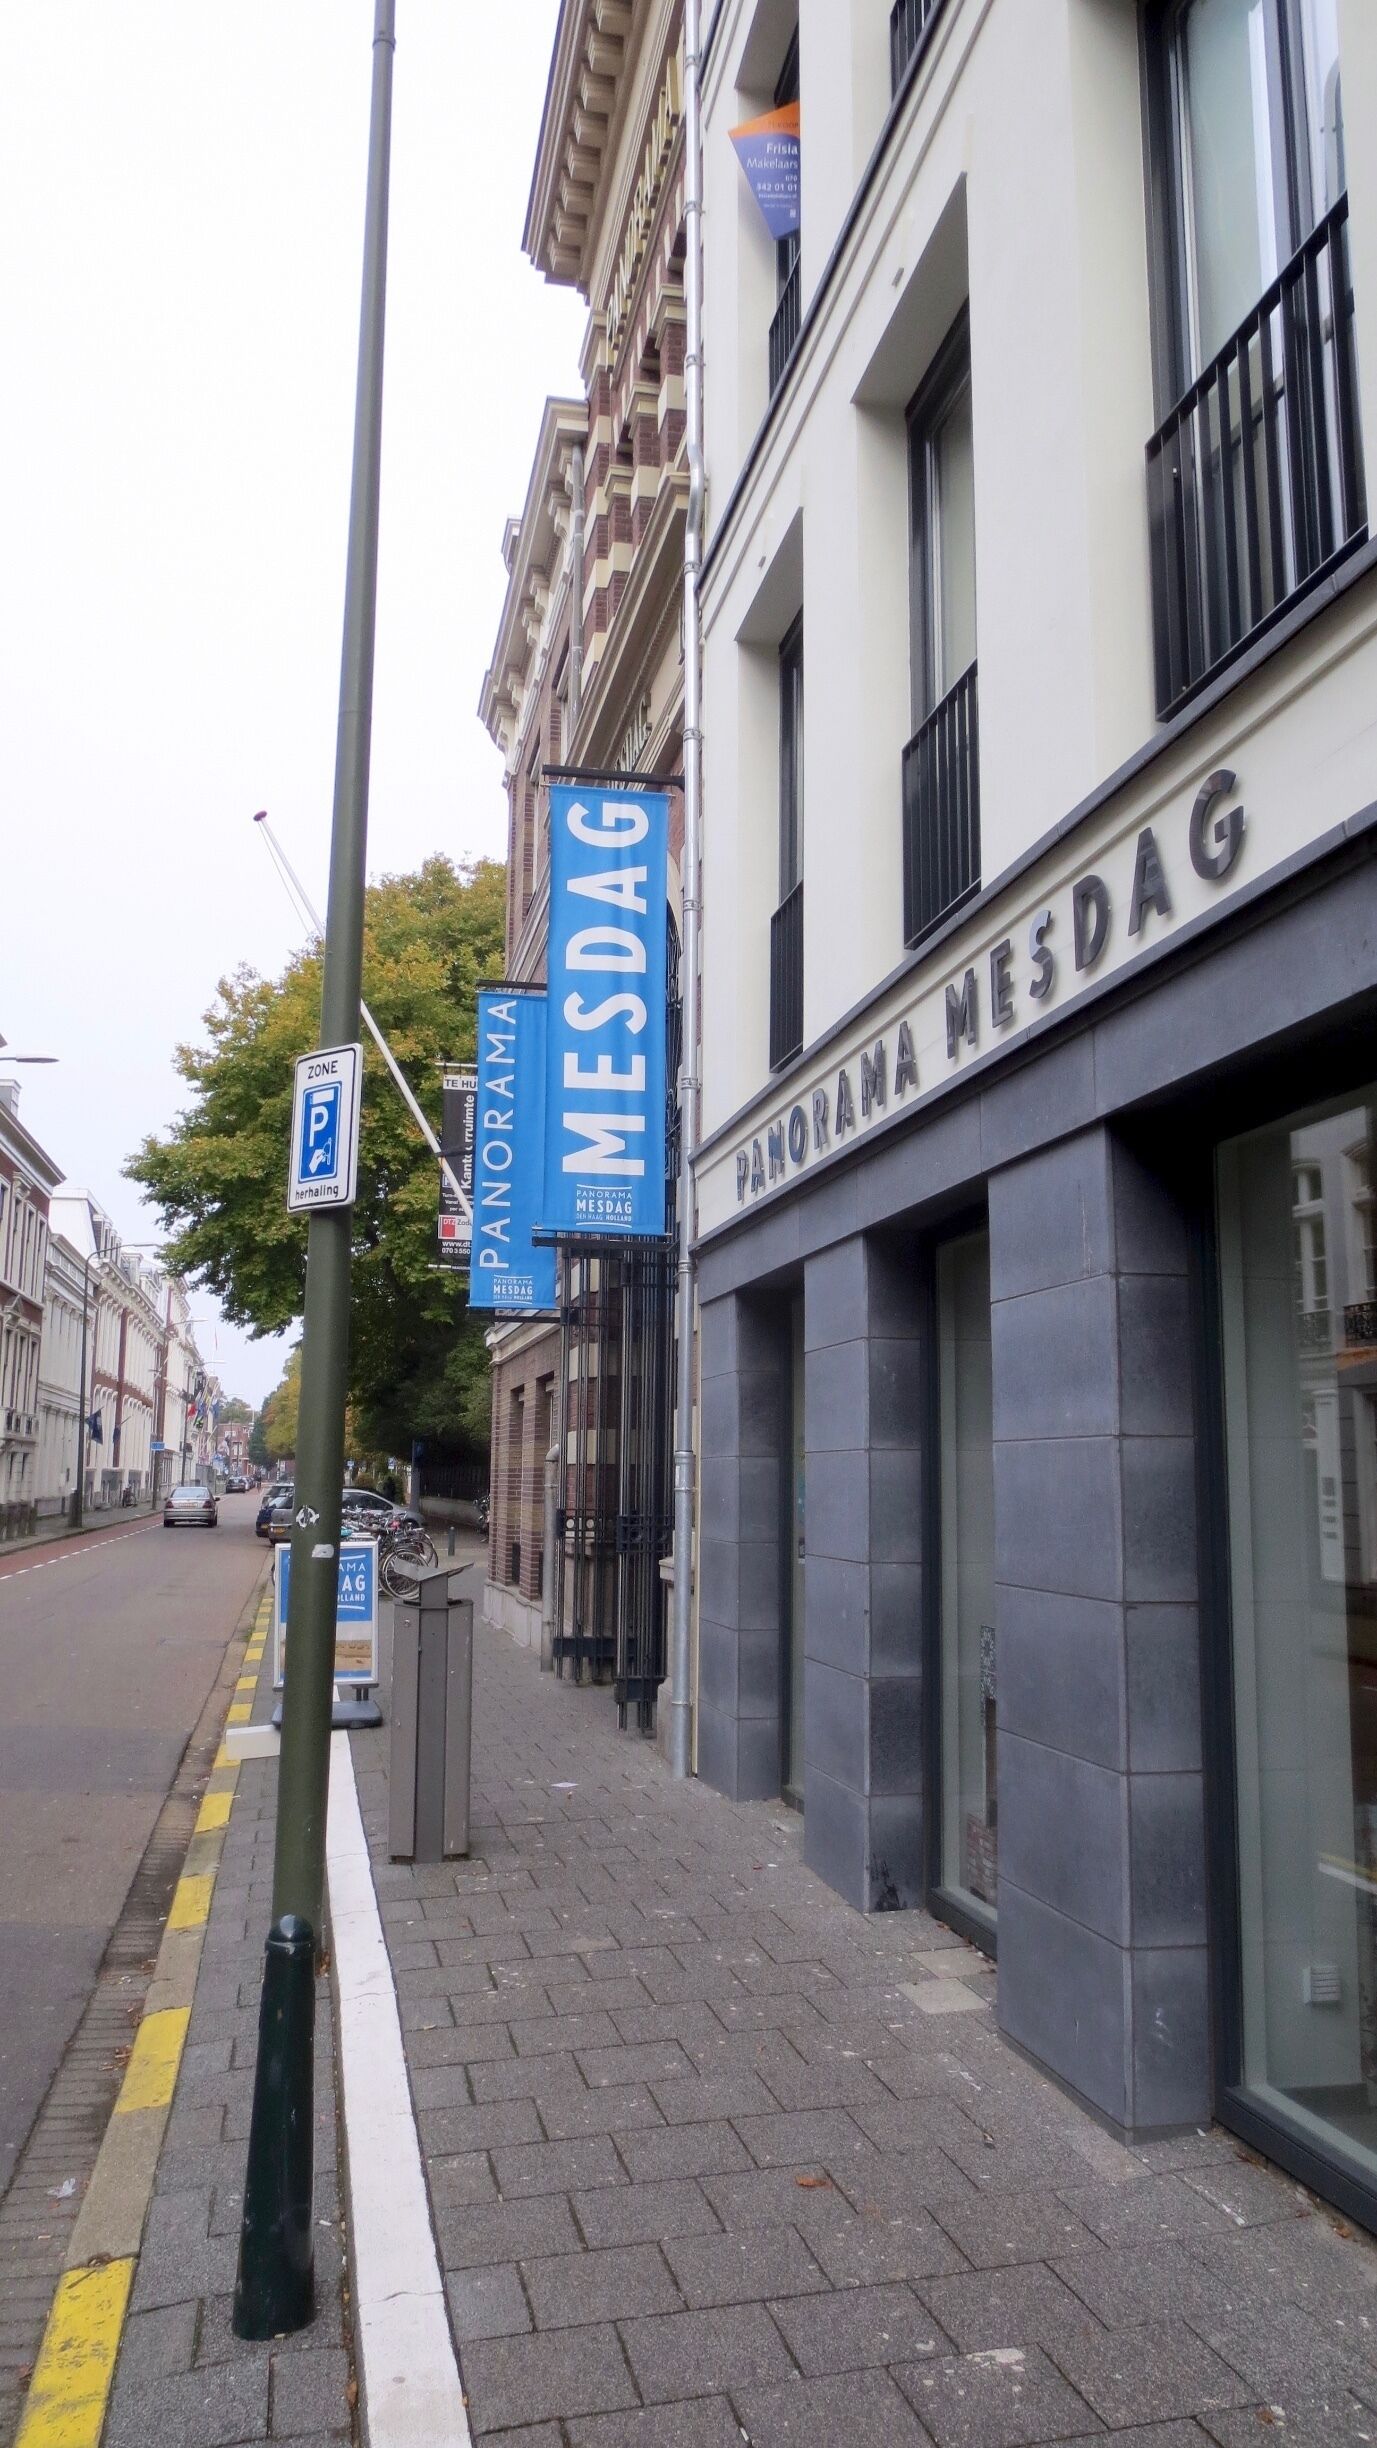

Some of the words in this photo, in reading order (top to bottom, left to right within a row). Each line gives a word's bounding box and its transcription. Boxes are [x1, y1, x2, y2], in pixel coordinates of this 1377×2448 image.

[766, 142, 798, 155] Frisia
[746, 158, 798, 169] Makelaars
[561, 801, 650, 1177] MESDAG
[736, 1020, 917, 1202] PANORAMA
[944, 769, 1245, 1060] MESDAG
[307, 1060, 338, 1080] ZONE
[445, 1079, 459, 1088] TE
[461, 1080, 477, 1089] HU
[309, 1105, 329, 1147] P
[479, 999, 518, 1269] PANORAMA
[295, 1184, 339, 1200] herhaling
[576, 1190, 632, 1200] PANORAMA
[576, 1199, 632, 1214] MESDAG
[493, 1284, 533, 1295] MESDAG
[337, 1593, 366, 1602] LLAND
